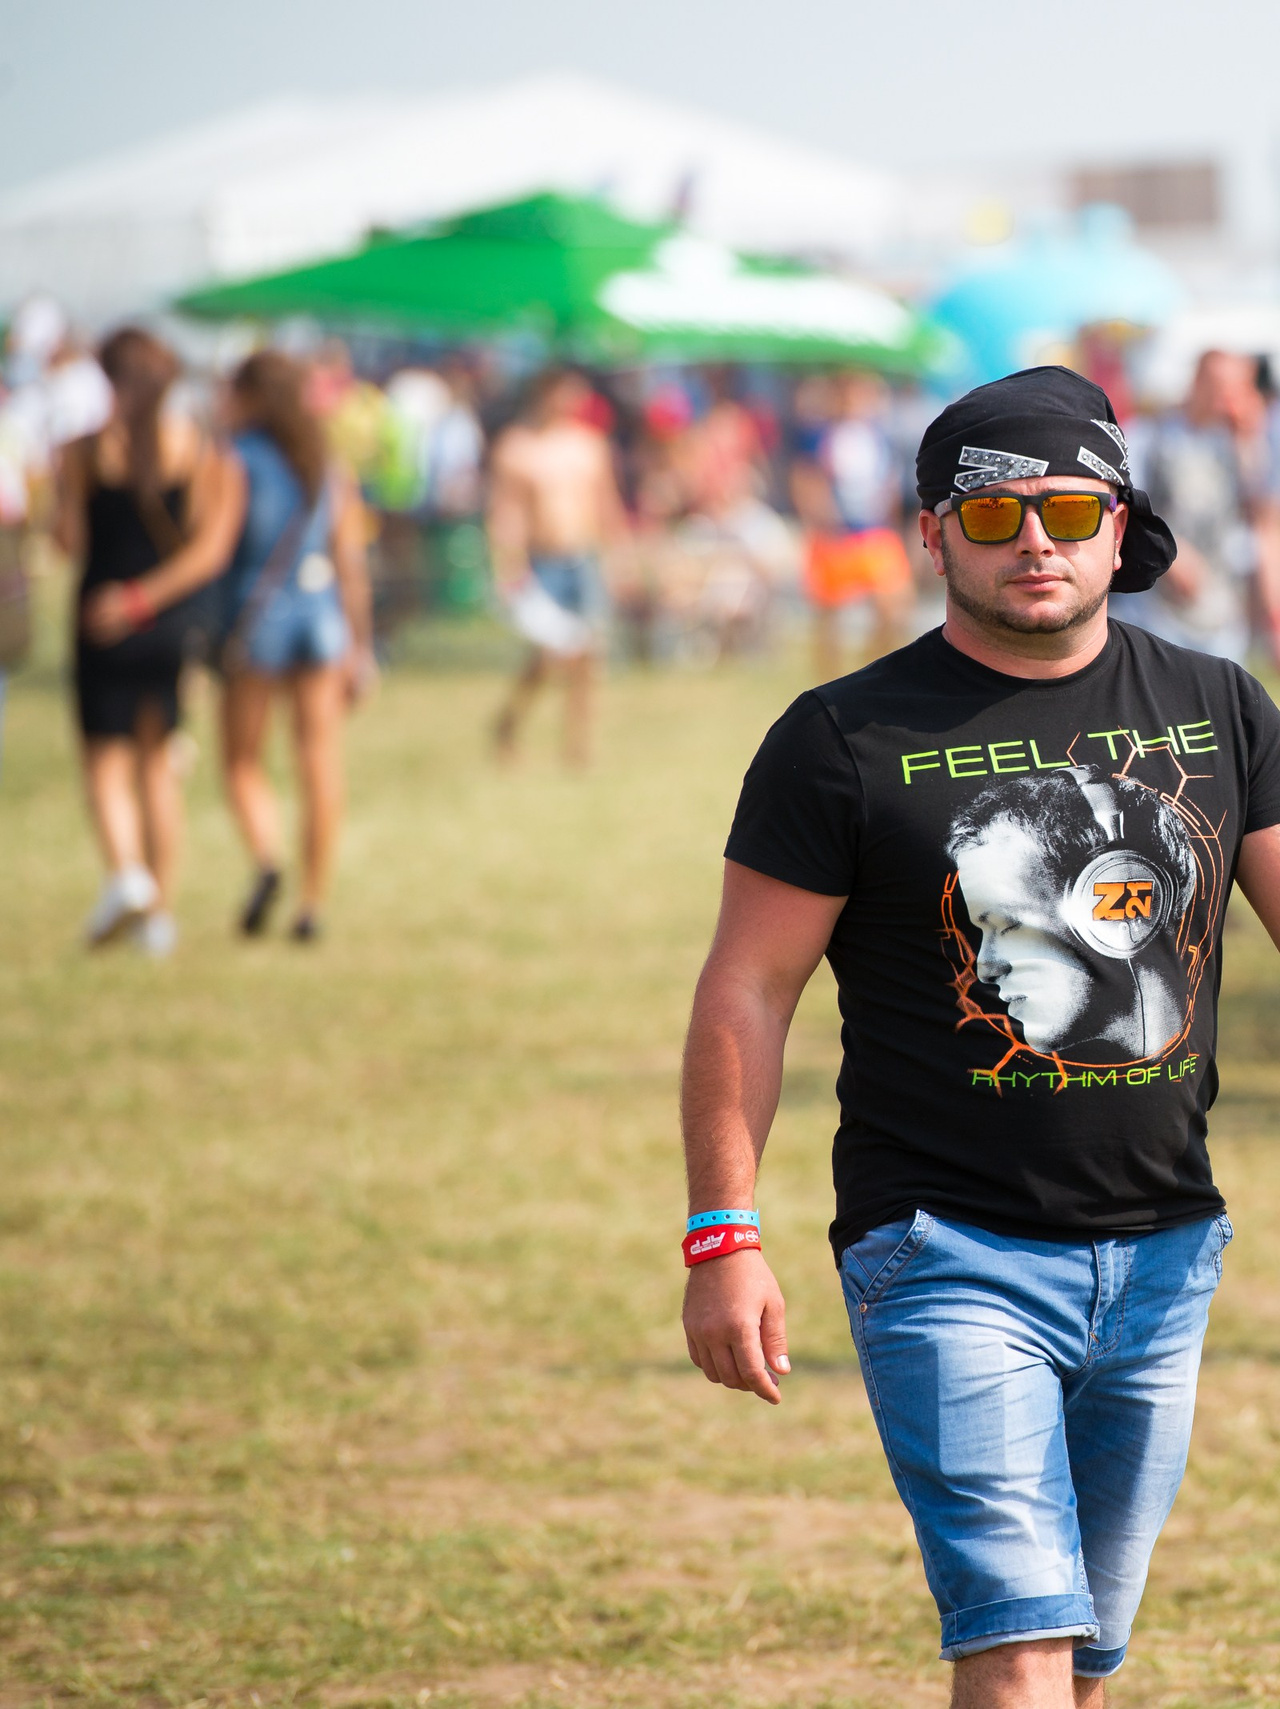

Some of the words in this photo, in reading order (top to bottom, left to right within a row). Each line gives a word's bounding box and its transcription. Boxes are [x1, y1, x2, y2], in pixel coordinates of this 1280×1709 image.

[901, 739, 1071, 785] FEEL
[1087, 720, 1219, 760] THE
[972, 1068, 1117, 1088] RHYTHM
[1126, 1066, 1161, 1085] OF
[1168, 1056, 1198, 1081] LIFE
